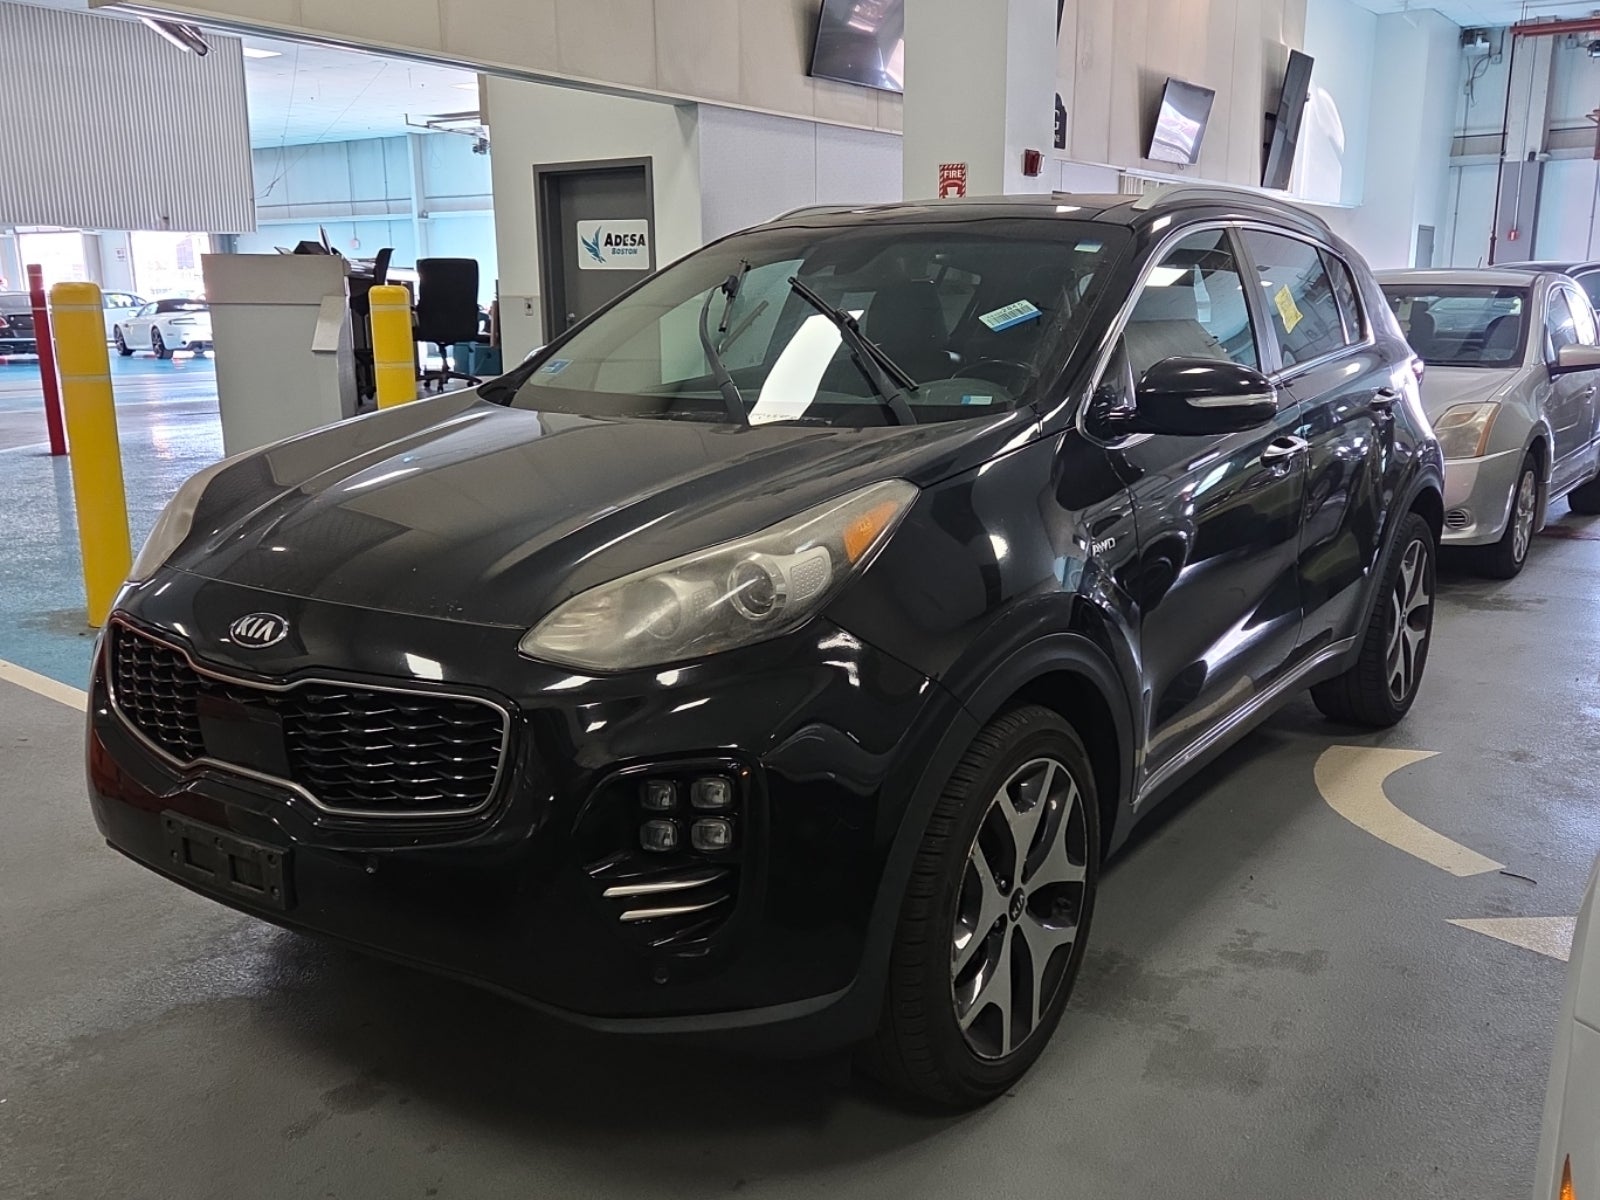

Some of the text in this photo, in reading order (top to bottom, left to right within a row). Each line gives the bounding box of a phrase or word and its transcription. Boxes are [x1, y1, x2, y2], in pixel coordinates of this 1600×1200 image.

[944, 170, 962, 179] FIRE
[604, 233, 646, 247] ADESA
[1092, 537, 1116, 557] AWD
[235, 616, 276, 641] KIA
[1012, 894, 1025, 918] KIA
